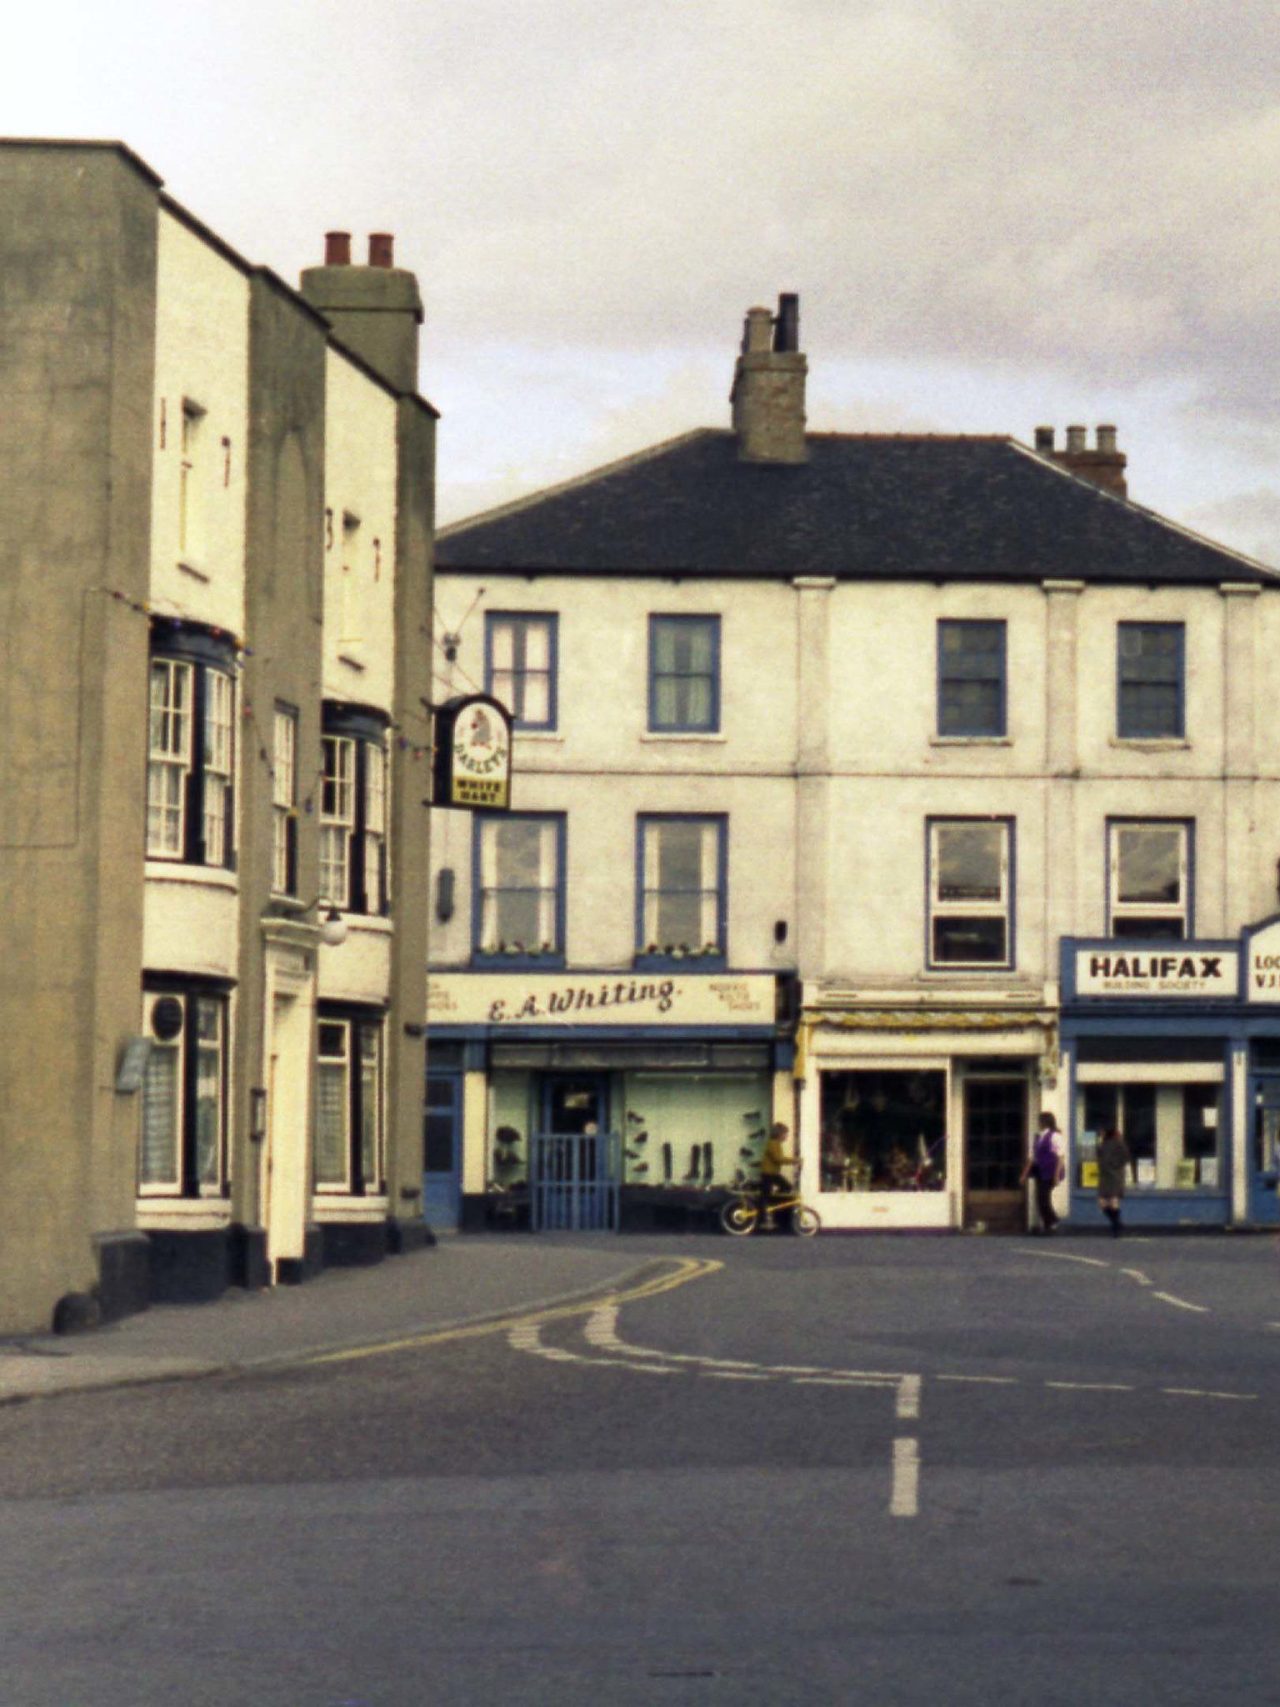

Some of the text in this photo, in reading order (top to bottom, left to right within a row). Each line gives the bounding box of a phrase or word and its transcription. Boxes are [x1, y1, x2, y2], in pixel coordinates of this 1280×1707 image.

[457, 780, 501, 792] WHITE
[460, 791, 496, 802] HART
[1090, 956, 1223, 979] HALIFAX
[1158, 980, 1206, 990] SOCIETY
[1255, 974, 1265, 988] V
[1268, 974, 1276, 988] J
